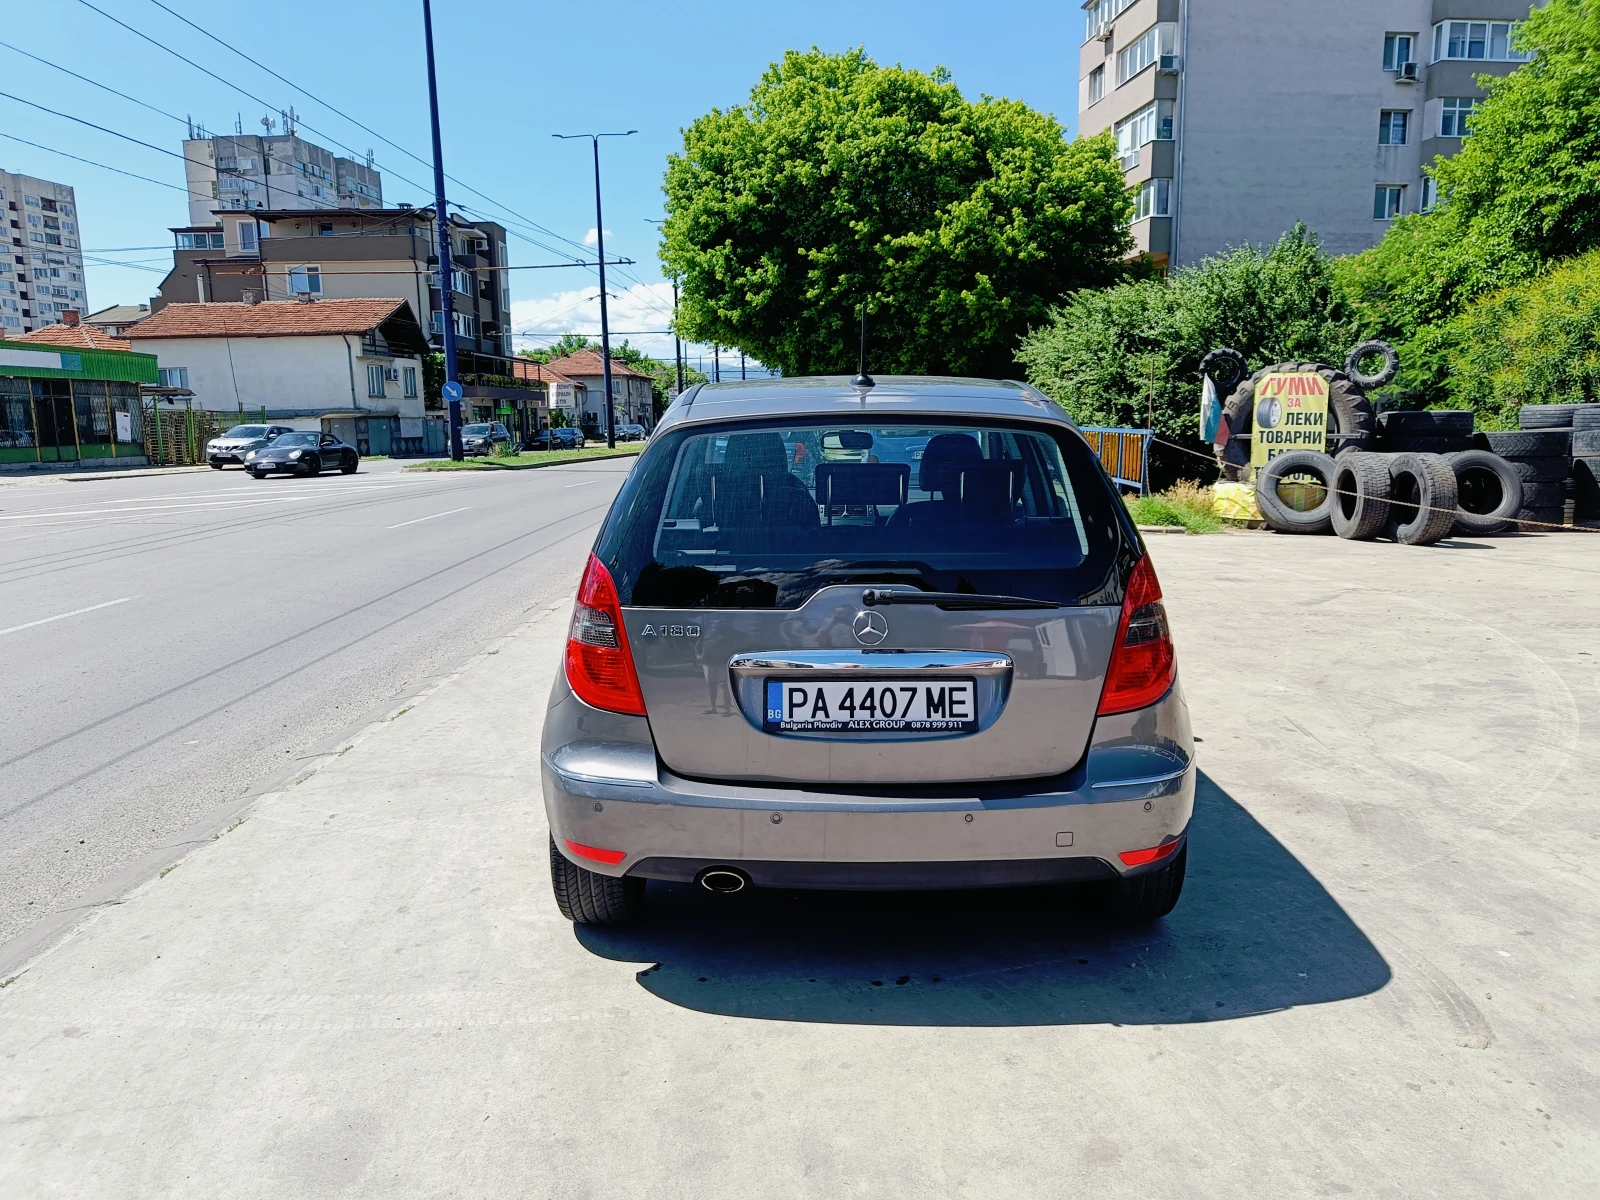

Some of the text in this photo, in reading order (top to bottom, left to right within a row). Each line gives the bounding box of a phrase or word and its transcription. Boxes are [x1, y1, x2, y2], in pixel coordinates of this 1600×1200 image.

[1260, 377, 1324, 396] ГУМИ
[1287, 398, 1301, 408] ЗА
[1285, 412, 1323, 426] ЛЕКИ
[1259, 431, 1322, 444] ТОВАРНИ
[788, 687, 968, 718] PA 4407 ME
[768, 710, 782, 718] BG
[780, 721, 812, 729] Bulgaria
[814, 721, 842, 729] Plovdiv
[848, 720, 870, 728] ALEX
[873, 720, 906, 728] GROUP
